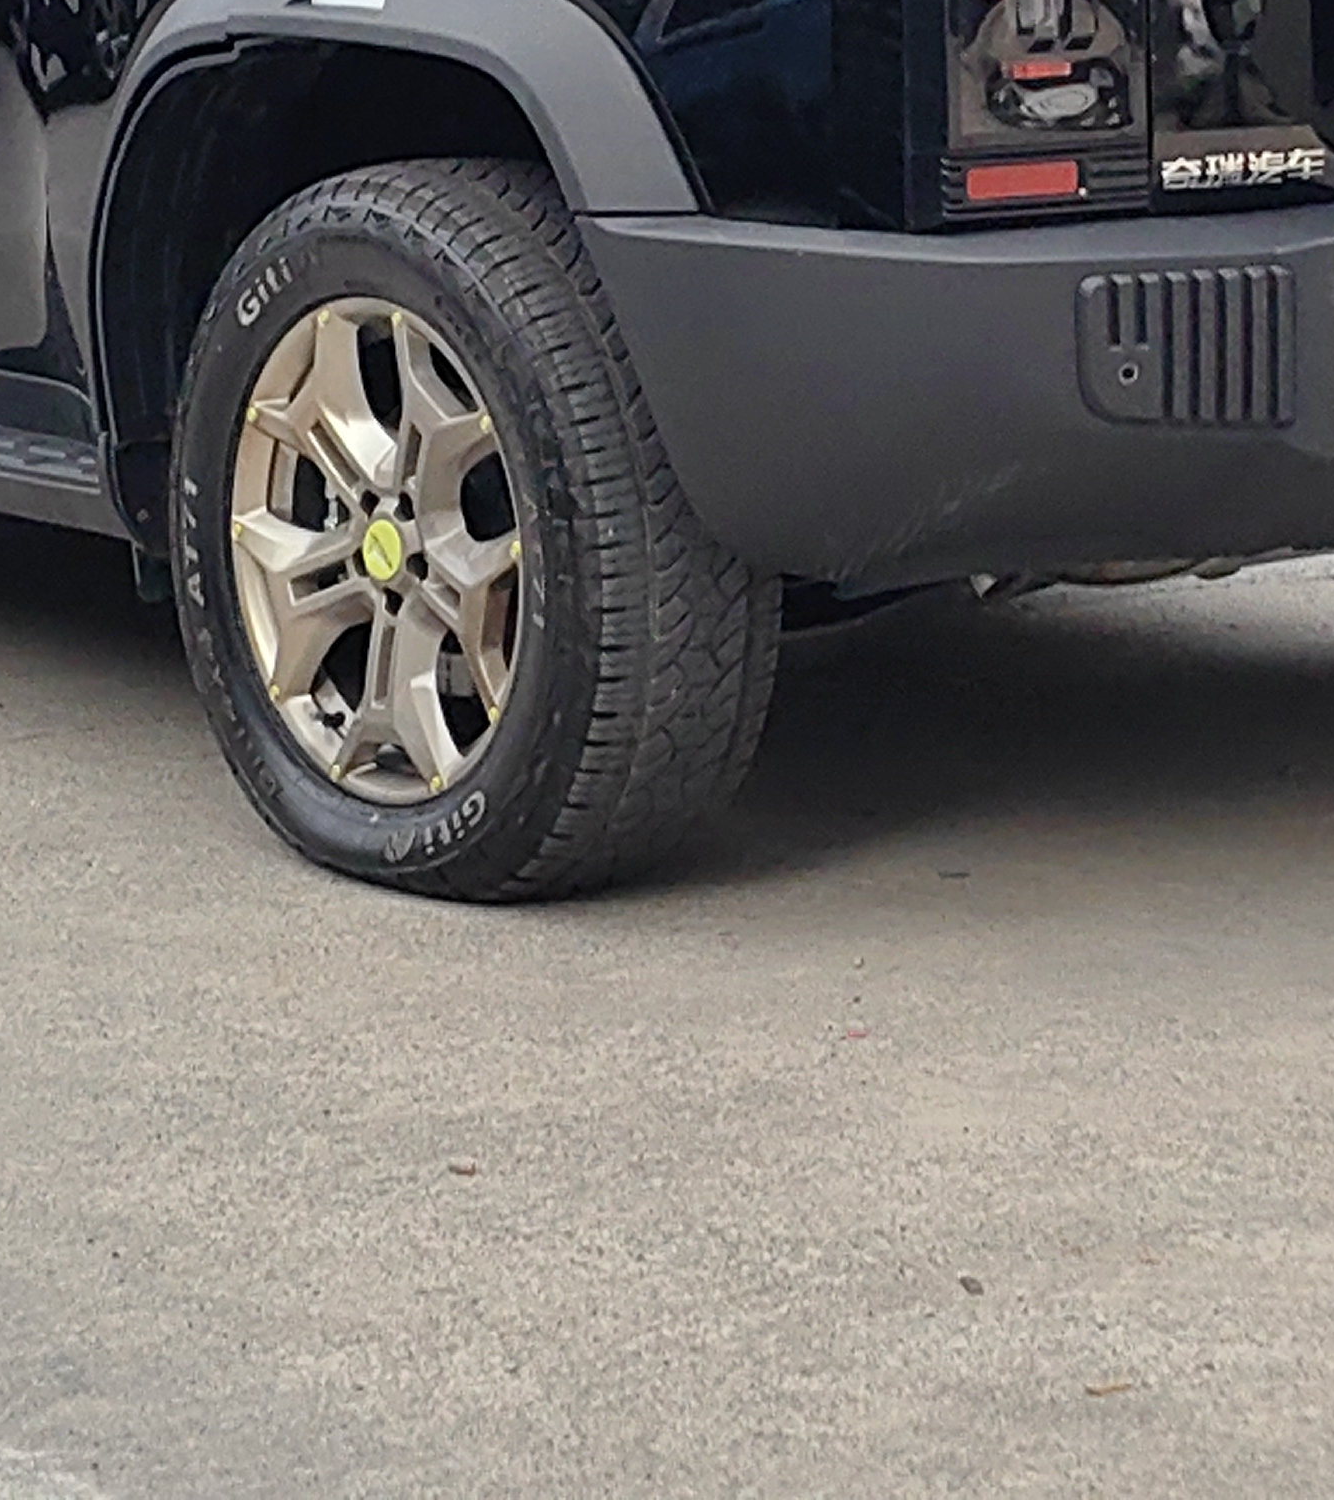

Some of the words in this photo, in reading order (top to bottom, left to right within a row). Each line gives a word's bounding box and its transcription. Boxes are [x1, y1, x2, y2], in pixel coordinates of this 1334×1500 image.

[1161, 148, 1326, 191] 奇瑞汽车
[236, 256, 293, 326] Giti
[423, 790, 486, 856] Giti
